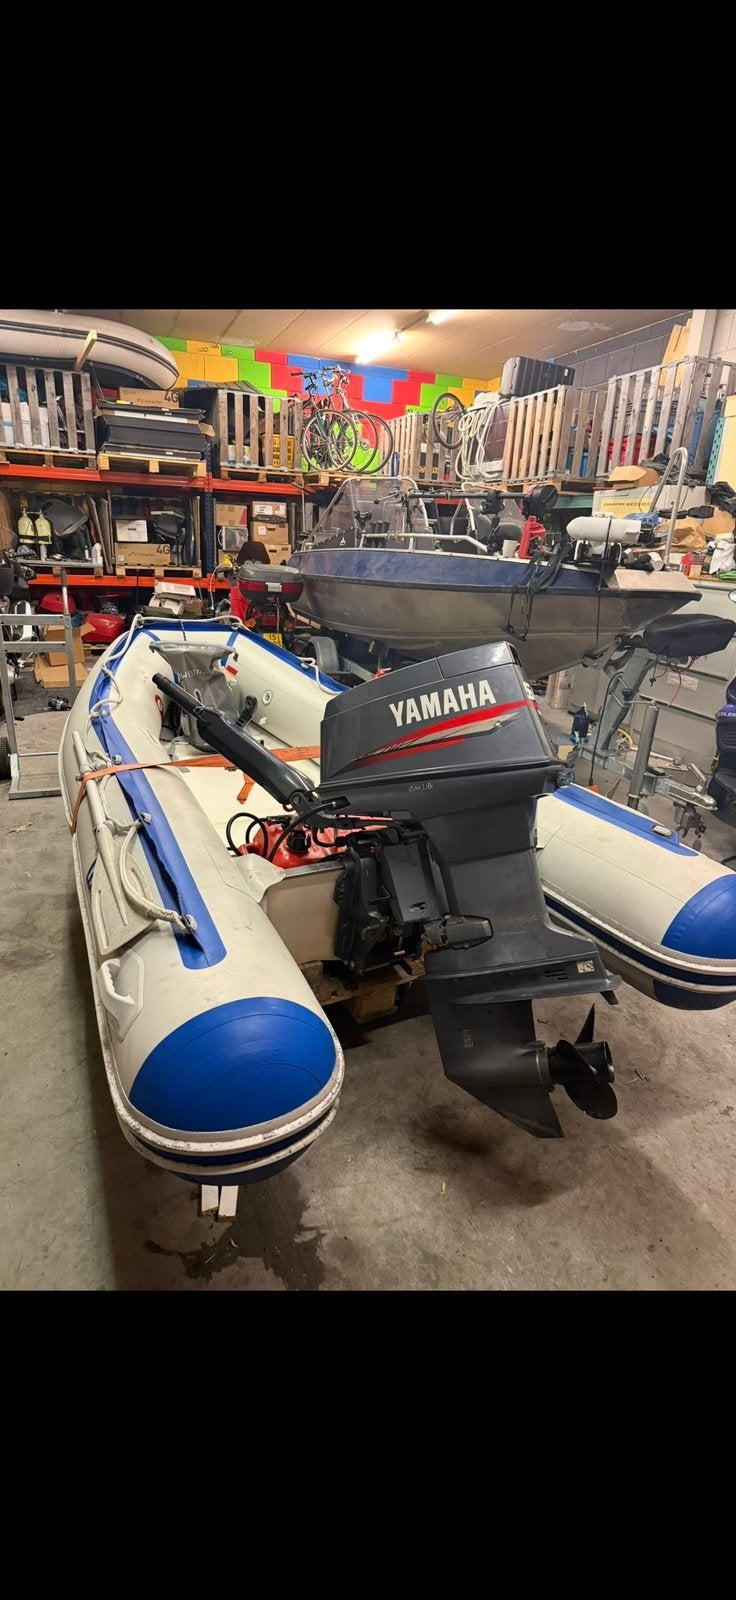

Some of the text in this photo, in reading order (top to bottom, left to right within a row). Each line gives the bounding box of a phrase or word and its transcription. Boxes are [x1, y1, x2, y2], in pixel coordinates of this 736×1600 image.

[164, 391, 179, 403] 4G
[156, 545, 170, 555] 4G
[389, 679, 497, 727] YAMAHA
